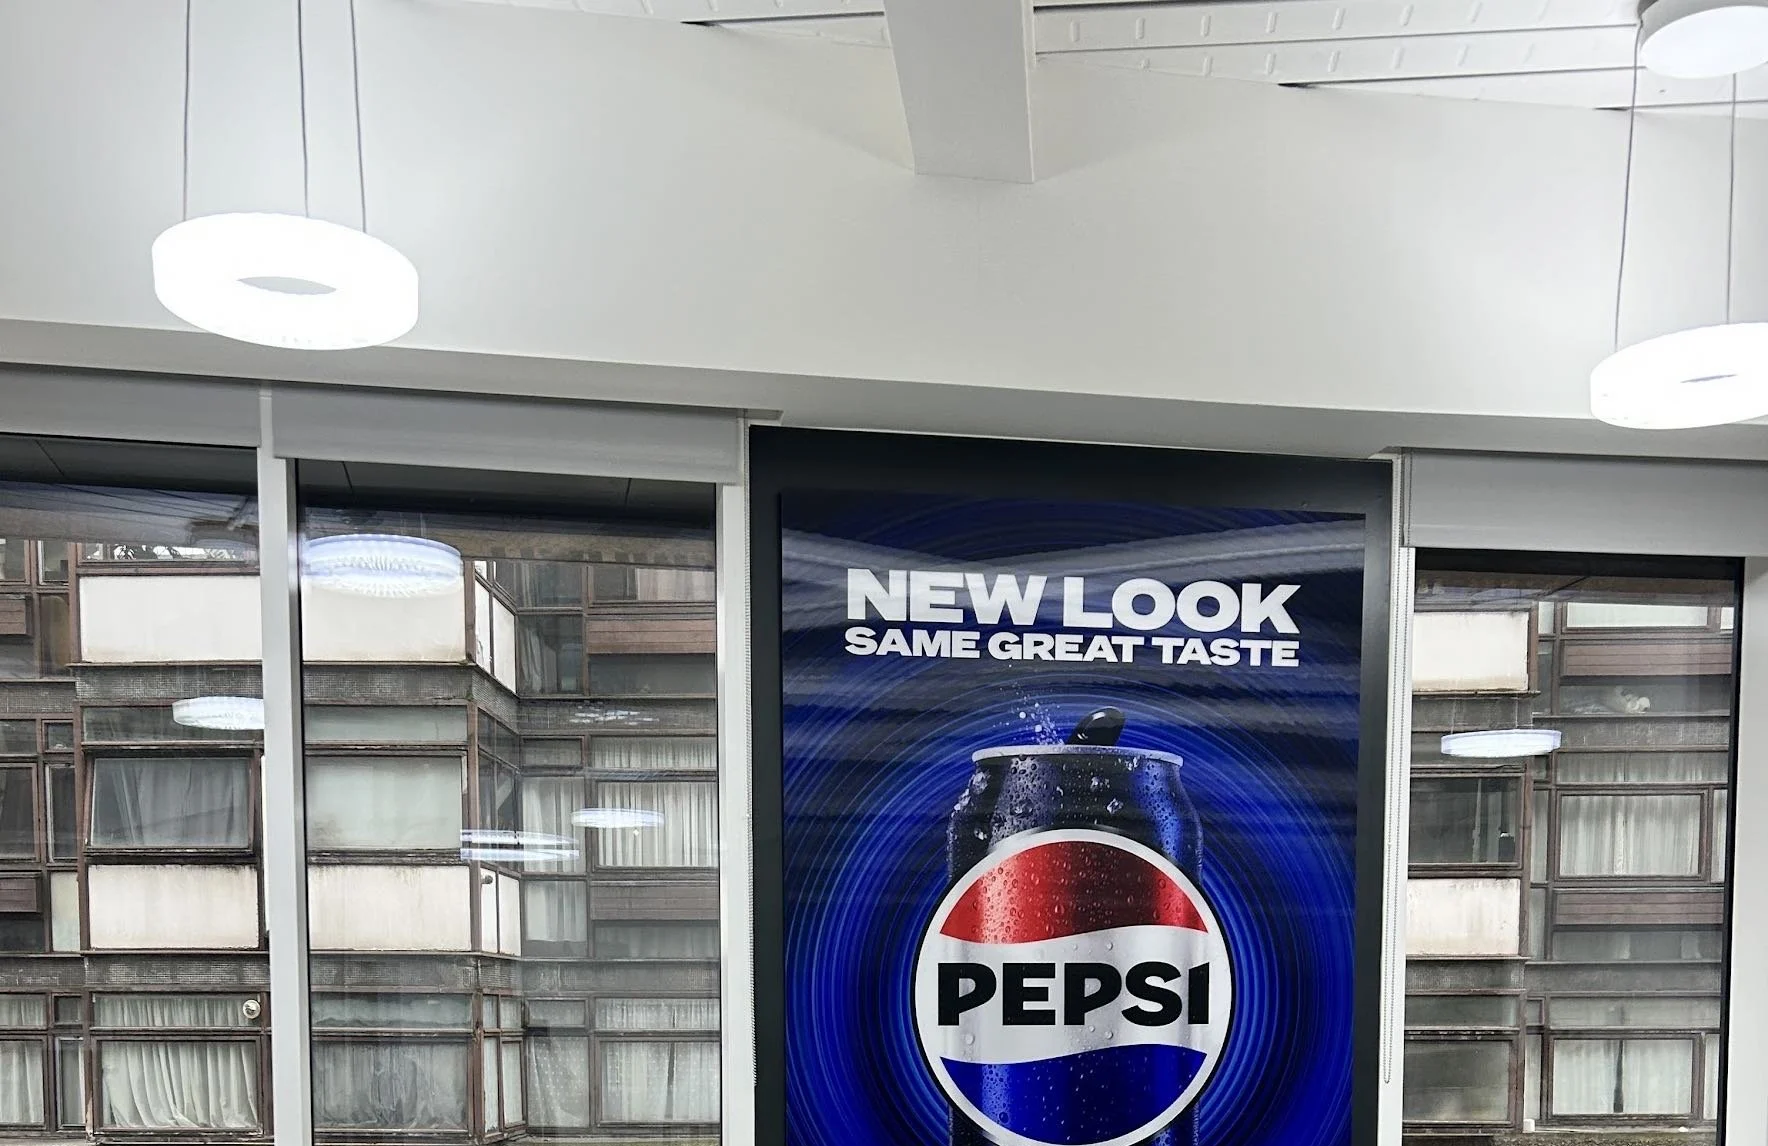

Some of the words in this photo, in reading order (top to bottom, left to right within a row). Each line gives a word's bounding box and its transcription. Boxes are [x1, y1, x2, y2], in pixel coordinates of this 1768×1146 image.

[847, 568, 1048, 626] NEW
[1063, 576, 1301, 634] LOOK
[844, 626, 981, 660] SAME
[987, 632, 1147, 663] GREAT
[1152, 637, 1300, 667] TASTE
[937, 961, 1210, 1027] PEPSI
